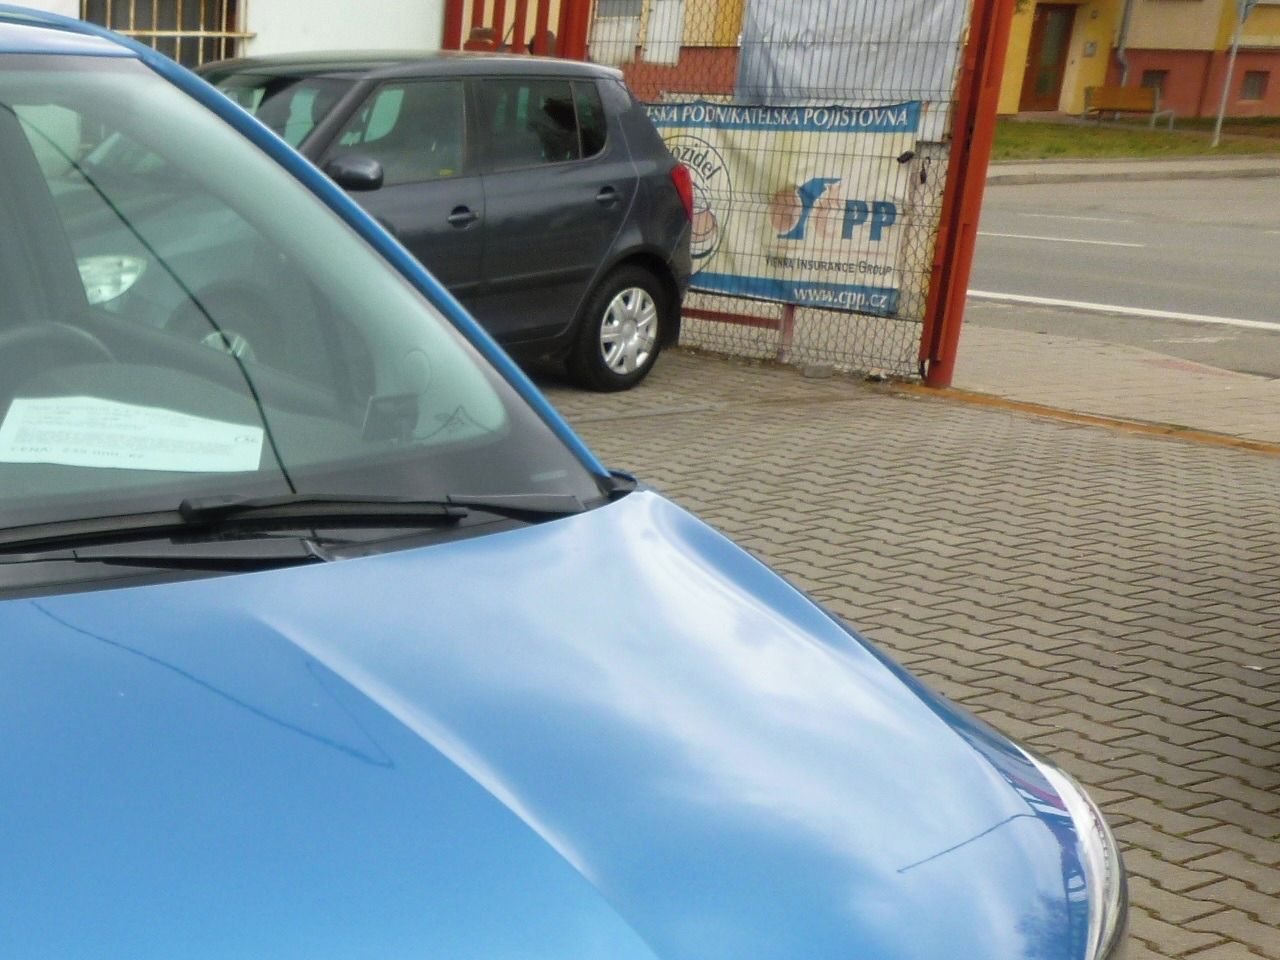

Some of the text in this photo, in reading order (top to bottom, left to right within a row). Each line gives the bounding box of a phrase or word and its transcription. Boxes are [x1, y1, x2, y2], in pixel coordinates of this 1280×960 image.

[646, 106, 677, 122] ESKA
[672, 144, 722, 180] ozidel
[797, 259, 855, 274] INSURANCE
[858, 260, 893, 276] GROUP
[793, 287, 889, 310] www.cpp.cz
